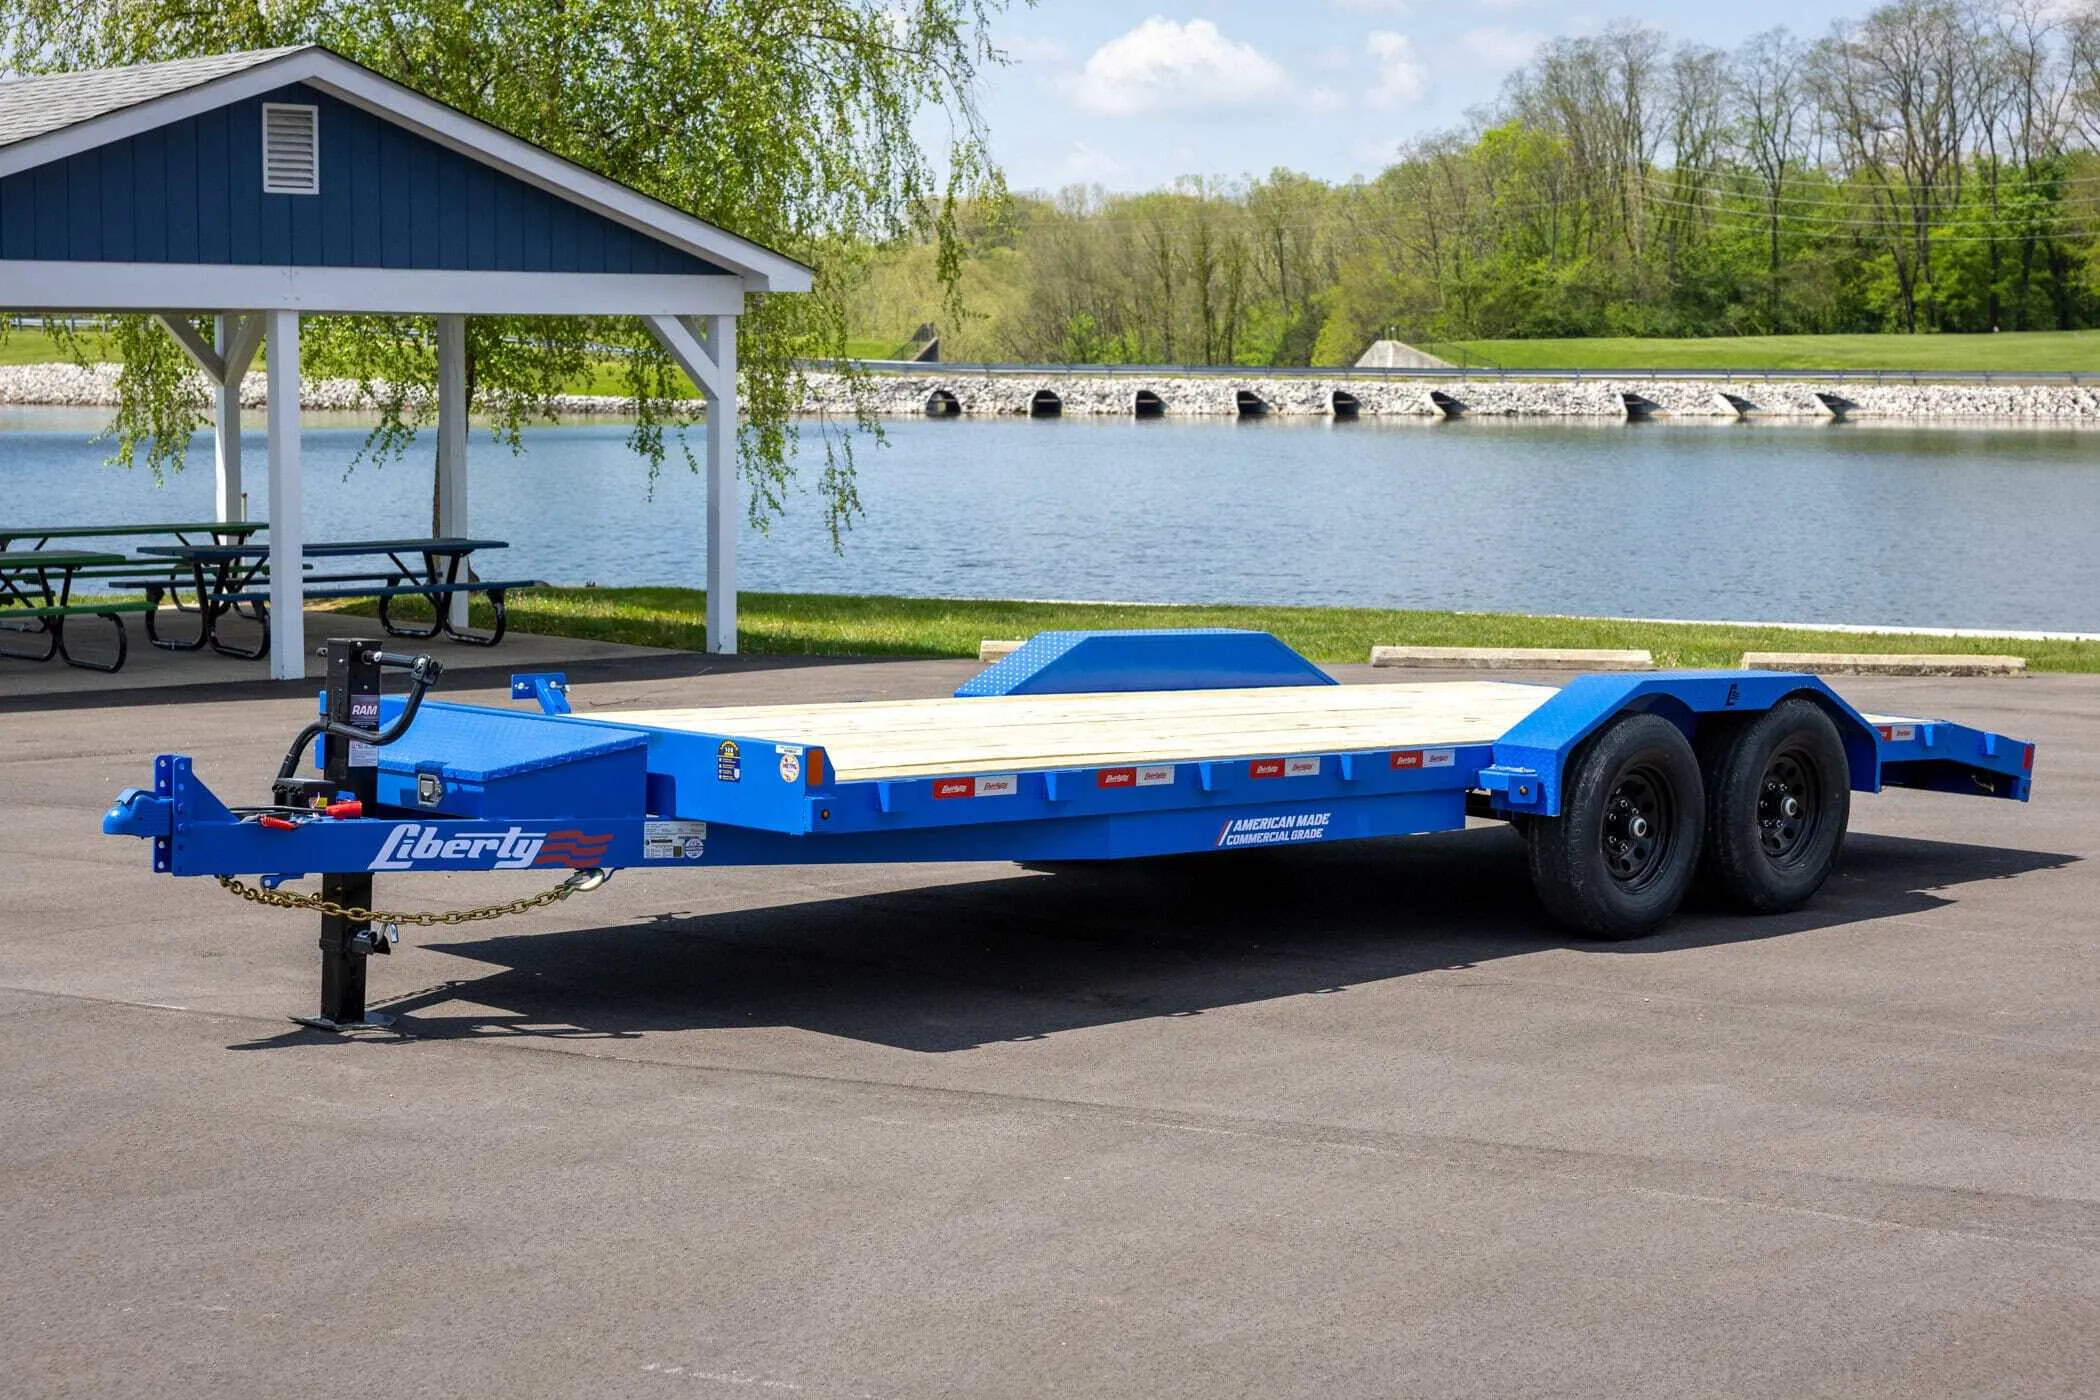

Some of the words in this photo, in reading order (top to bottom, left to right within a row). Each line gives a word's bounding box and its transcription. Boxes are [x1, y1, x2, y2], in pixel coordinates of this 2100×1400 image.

[352, 704, 378, 716] RAM
[1233, 815, 1296, 832] AMERICAN
[1296, 812, 1331, 827] MADE
[367, 823, 547, 870] Liberty
[1226, 830, 1290, 846] COMMERCIAL
[1290, 828, 1324, 841] GRADE
